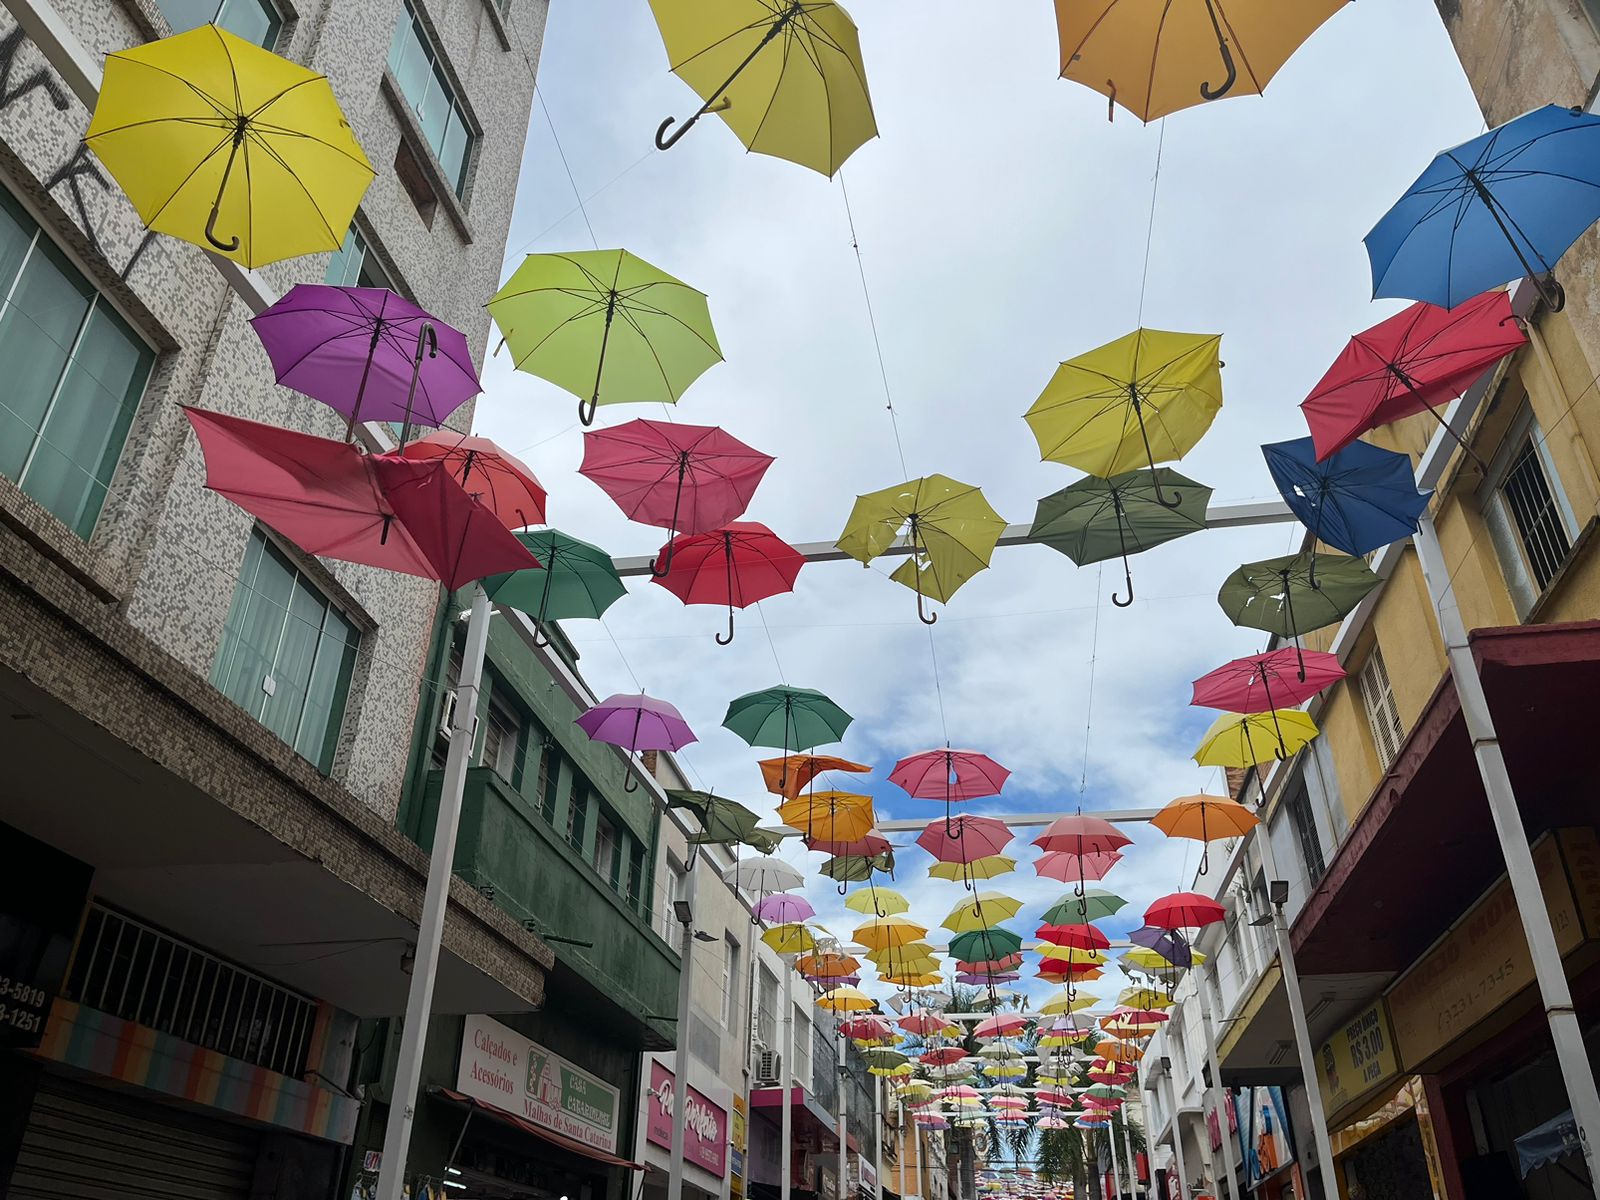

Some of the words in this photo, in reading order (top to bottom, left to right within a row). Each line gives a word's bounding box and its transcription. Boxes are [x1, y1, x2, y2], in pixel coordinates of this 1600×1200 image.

[0, 975, 45, 1008] 3-5819
[474, 1028, 512, 1063] Calçados
[512, 1055, 518, 1066] e
[470, 1060, 514, 1095] Acessórios
[569, 1074, 587, 1095] CASA
[522, 1098, 552, 1126] Malhas
[553, 1113, 563, 1129] de
[563, 1119, 583, 1140] Santa
[584, 1126, 612, 1150] Catarina
